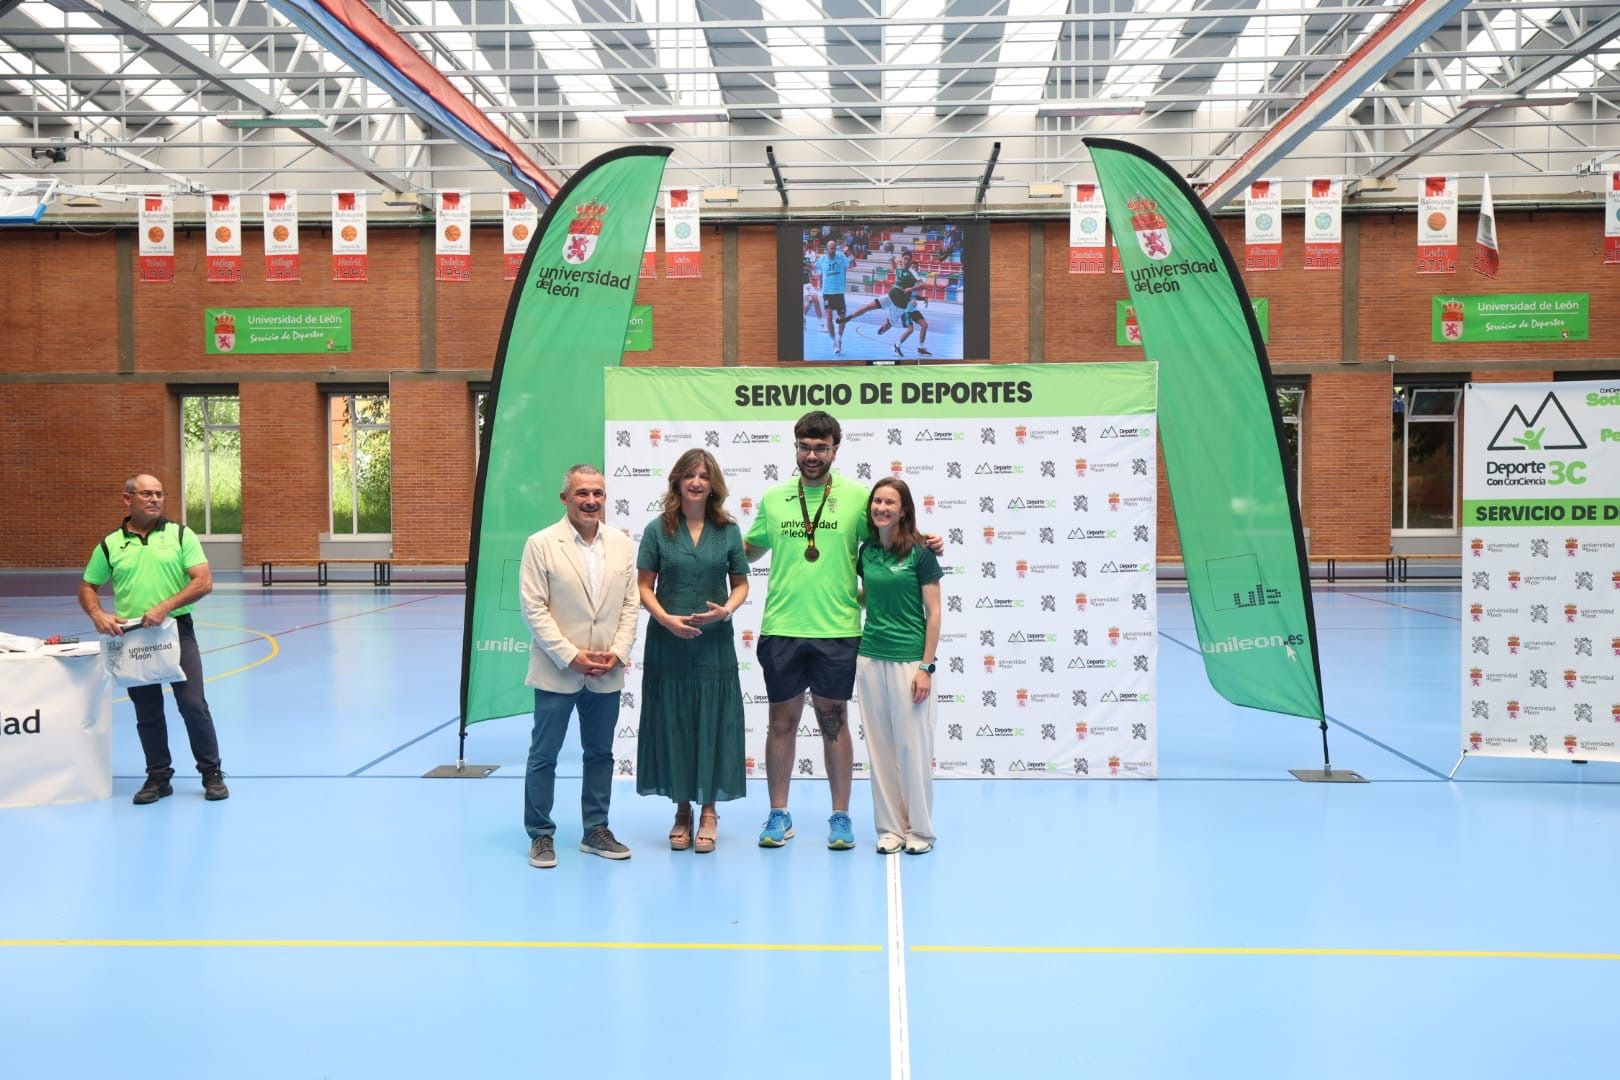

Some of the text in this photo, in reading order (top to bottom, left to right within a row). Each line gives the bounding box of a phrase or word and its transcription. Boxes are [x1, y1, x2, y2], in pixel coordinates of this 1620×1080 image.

[1130, 258, 1218, 282] universidad
[539, 266, 632, 290] universidad
[1478, 300, 1579, 312] Universidad de León
[248, 313, 342, 324] Universidad de León
[630, 317, 644, 326] ón
[1486, 322, 1516, 332] Servicio
[1518, 320, 1529, 329] de
[250, 334, 280, 344] Servicio
[281, 332, 290, 340] de
[734, 381, 1033, 407] SERVICIO DE DEPORTES
[1487, 461, 1587, 486] Deporte 3C
[1504, 477, 1546, 486] ConCiencia
[1476, 504, 1620, 521] SERVICIO DE D
[128, 642, 172, 654] universidad
[476, 636, 533, 652] unile
[0, 708, 40, 736] ad
